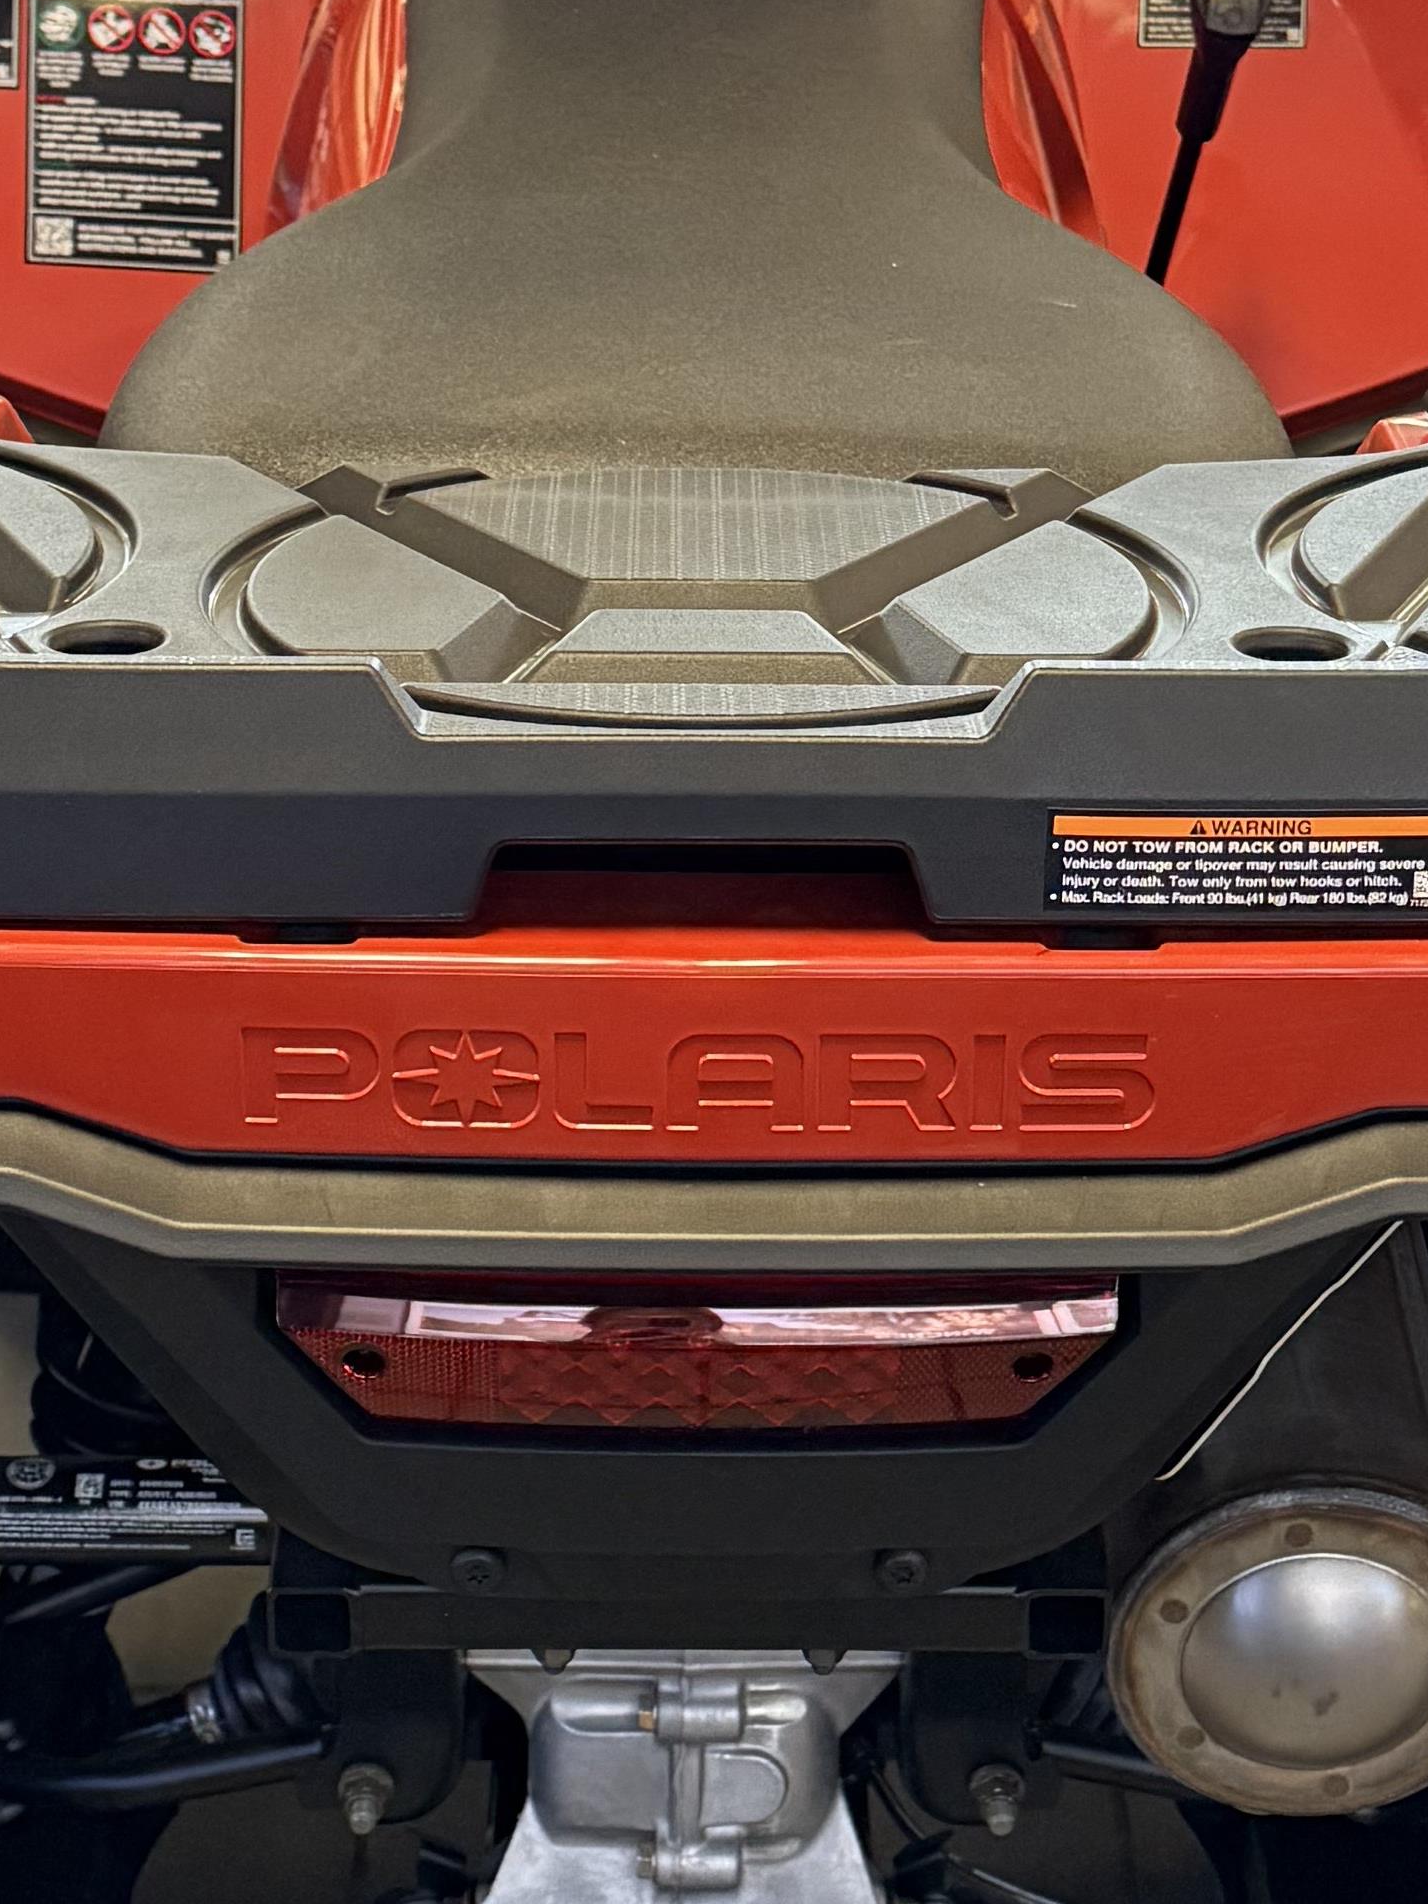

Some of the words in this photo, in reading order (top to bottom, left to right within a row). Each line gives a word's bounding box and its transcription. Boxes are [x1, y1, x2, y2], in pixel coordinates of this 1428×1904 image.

[1212, 820, 1312, 835] WARNING
[1064, 840, 1088, 853] DO
[1093, 841, 1128, 853] NOT
[1132, 841, 1171, 854] TOW
[1175, 841, 1223, 854] FROM
[1228, 841, 1274, 854] RACK
[1279, 841, 1303, 854] OR
[1308, 841, 1384, 854] BUMPER.
[1062, 857, 1113, 870] Vehicle
[1116, 858, 1172, 873] damage
[1176, 861, 1191, 870] or
[1195, 858, 1243, 873] tipover
[1246, 861, 1275, 873] may
[1279, 858, 1318, 870] result
[1321, 858, 1375, 873] causing
[1379, 860, 1425, 870] severe
[1103, 877, 1118, 887] or
[1122, 875, 1164, 887] death.
[1169, 875, 1199, 887] Tow
[1202, 875, 1232, 890] only
[1235, 875, 1267, 887] from
[1272, 876, 1297, 887] tow
[1300, 875, 1342, 887] hooks
[1346, 877, 1361, 887] or
[1364, 875, 1402, 887] hitch.
[1062, 892, 1090, 904] Max.
[1093, 891, 1125, 904] Rack
[1127, 892, 1169, 904] Loads:
[1172, 892, 1205, 904] Front
[1207, 892, 1223, 904] 90
[1289, 892, 1319, 905] Rear
[240, 1026, 1156, 1133] POLARIS
